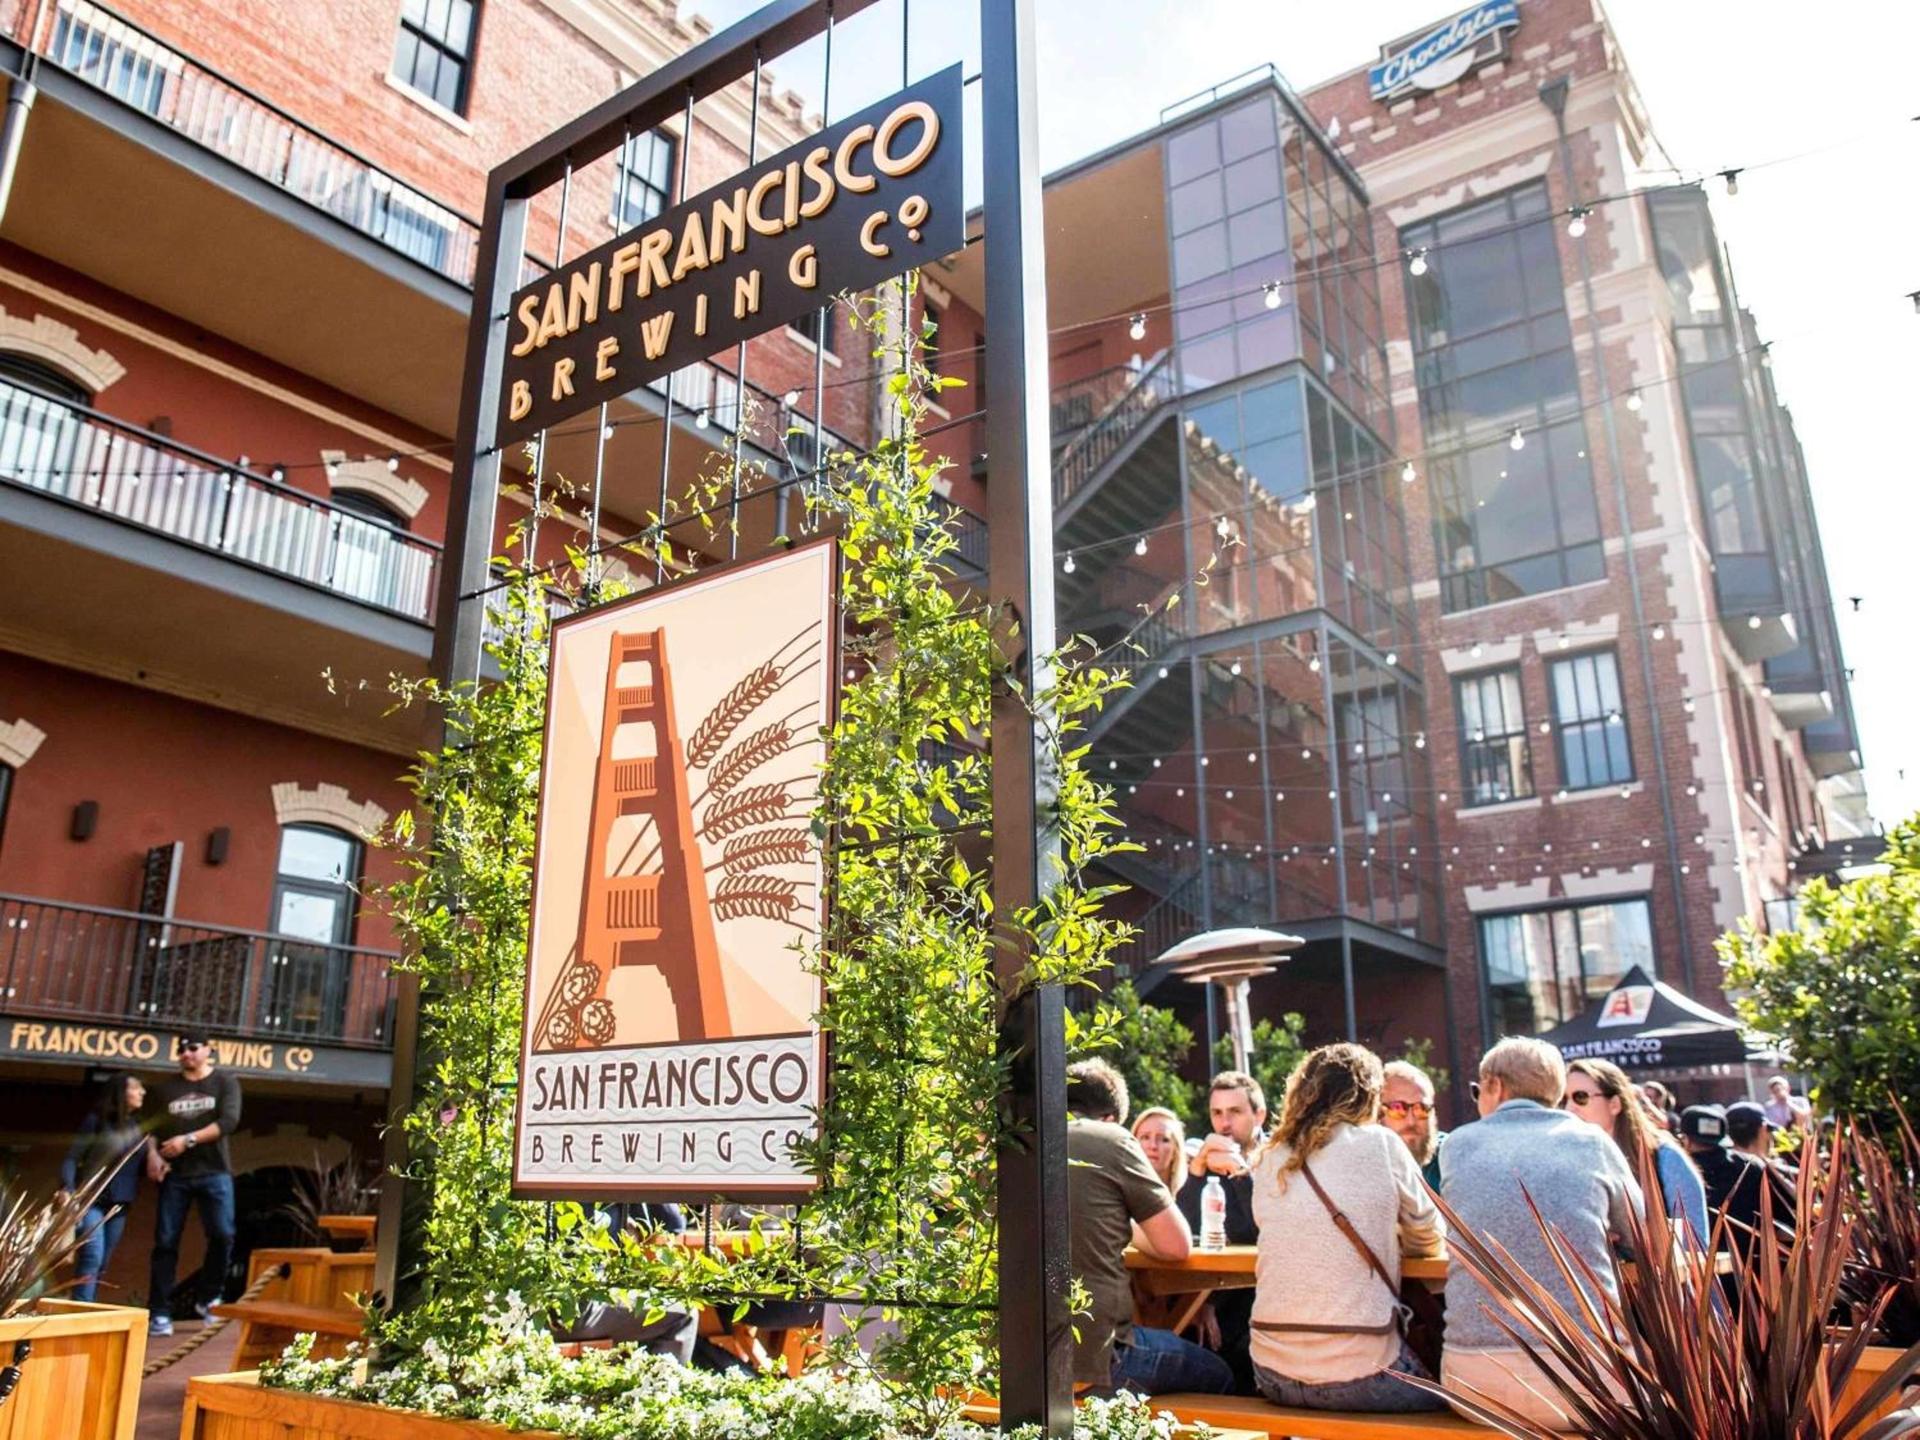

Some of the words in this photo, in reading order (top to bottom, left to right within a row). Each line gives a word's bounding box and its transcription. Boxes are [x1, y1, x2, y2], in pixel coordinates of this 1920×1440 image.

[512, 260, 602, 357] SAN
[607, 101, 939, 312] FRANCISCO
[510, 244, 818, 422] BREWING
[10, 1022, 158, 1060] FRANCISCO
[1586, 1038, 1662, 1056] FRANCISCO
[532, 1064, 590, 1112] SAN
[599, 1052, 808, 1110] FRANCISCO
[531, 1131, 732, 1163] BREWING
